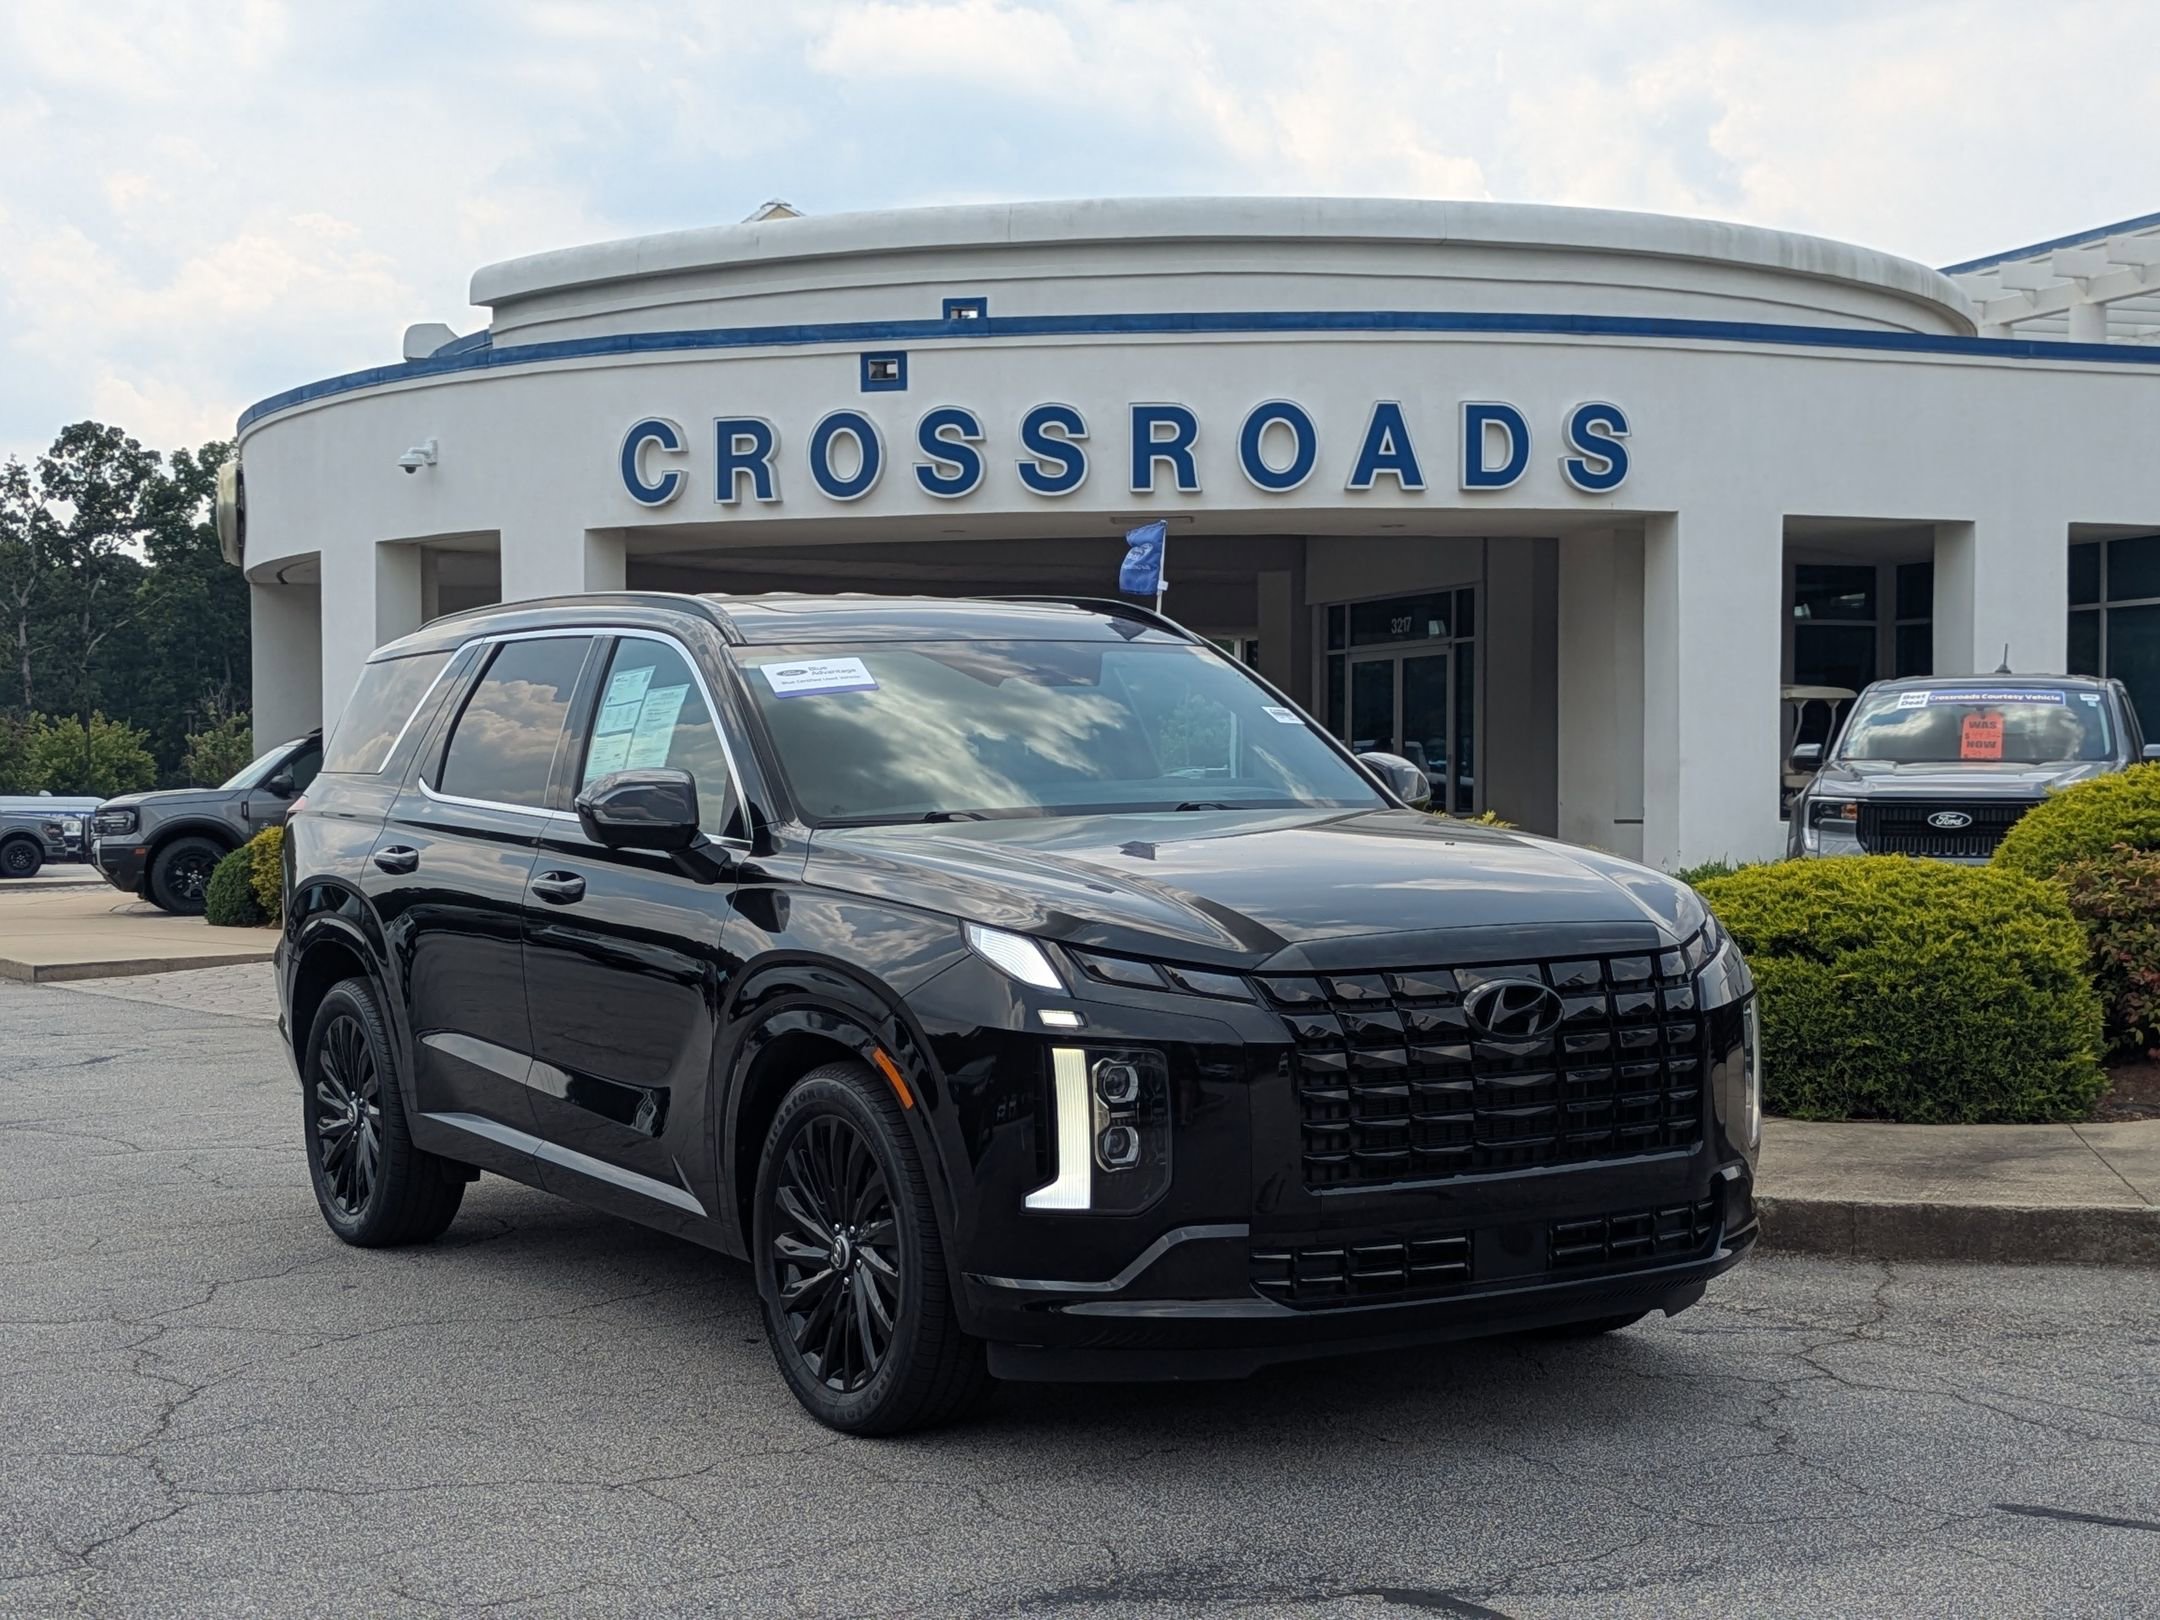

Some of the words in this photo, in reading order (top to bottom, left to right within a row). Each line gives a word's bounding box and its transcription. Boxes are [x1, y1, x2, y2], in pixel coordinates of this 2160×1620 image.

[619, 399, 1632, 508] CROSSROADS
[1391, 616, 1412, 634] 3217
[1929, 693, 1980, 701] Crossroads
[1981, 693, 2024, 701] Courtesy
[2024, 693, 2061, 701] Vehicle
[1968, 720, 1998, 729] WAS
[1966, 740, 1998, 749] NOW
